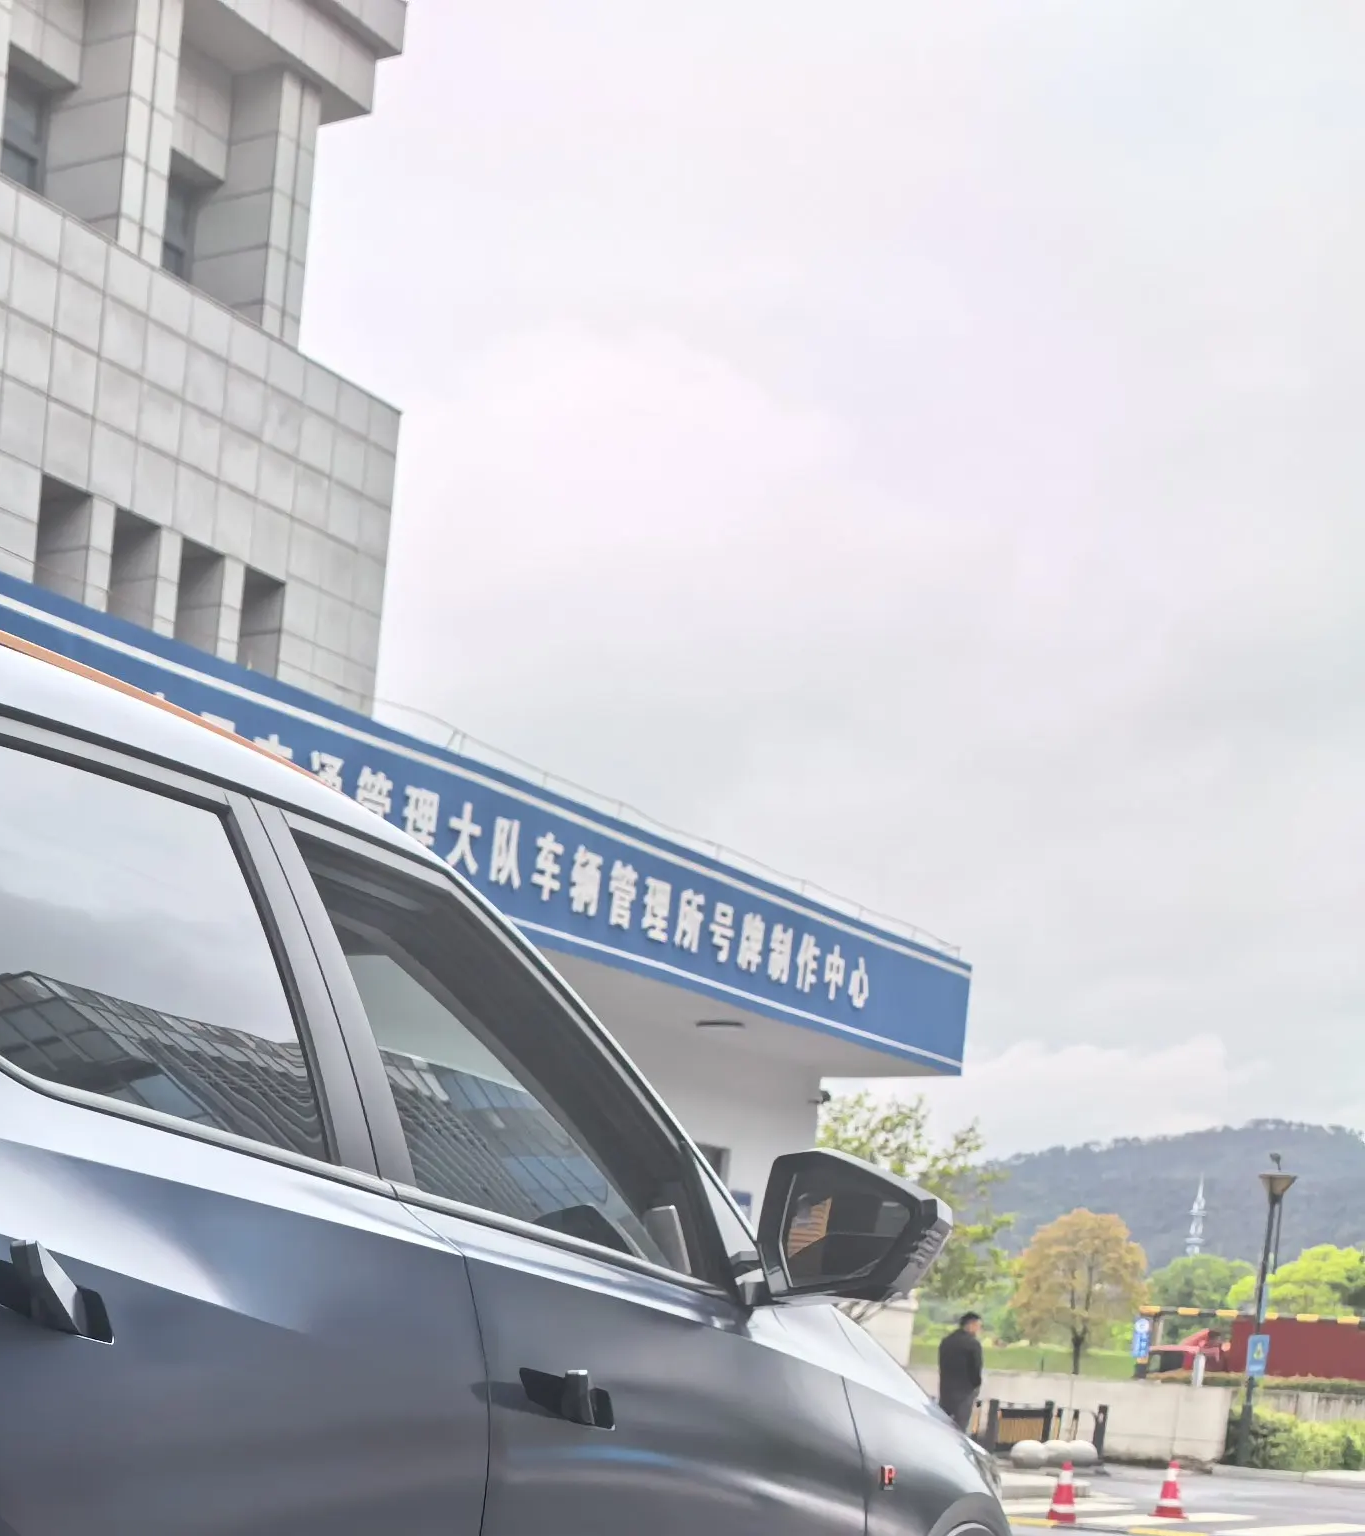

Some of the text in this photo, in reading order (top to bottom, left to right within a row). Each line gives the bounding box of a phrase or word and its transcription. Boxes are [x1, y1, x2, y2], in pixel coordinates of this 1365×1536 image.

[153, 692, 869, 1009] 通管理大队车辆管理所号牌制作中心
